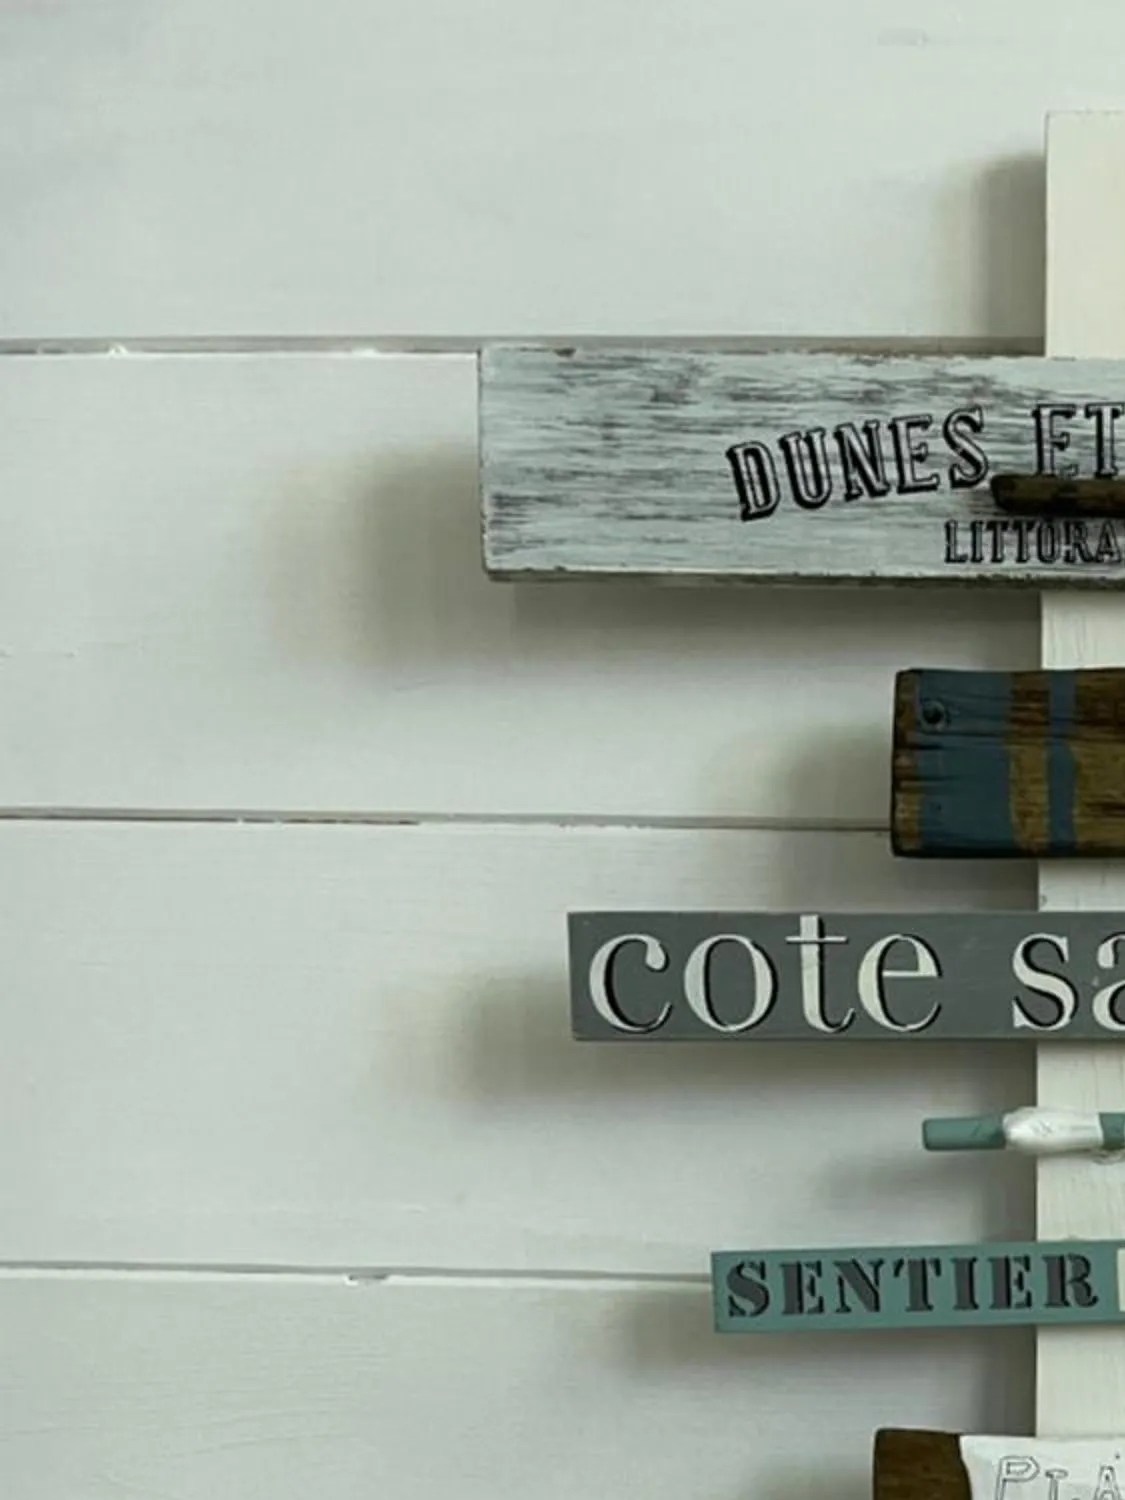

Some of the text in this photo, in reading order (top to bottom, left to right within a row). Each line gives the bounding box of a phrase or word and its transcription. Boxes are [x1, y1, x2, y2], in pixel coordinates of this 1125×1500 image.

[726, 404, 990, 520] DUNES
[1031, 401, 1125, 480] ET
[588, 915, 943, 1033] cote
[725, 1252, 1098, 1318] SENTIER
